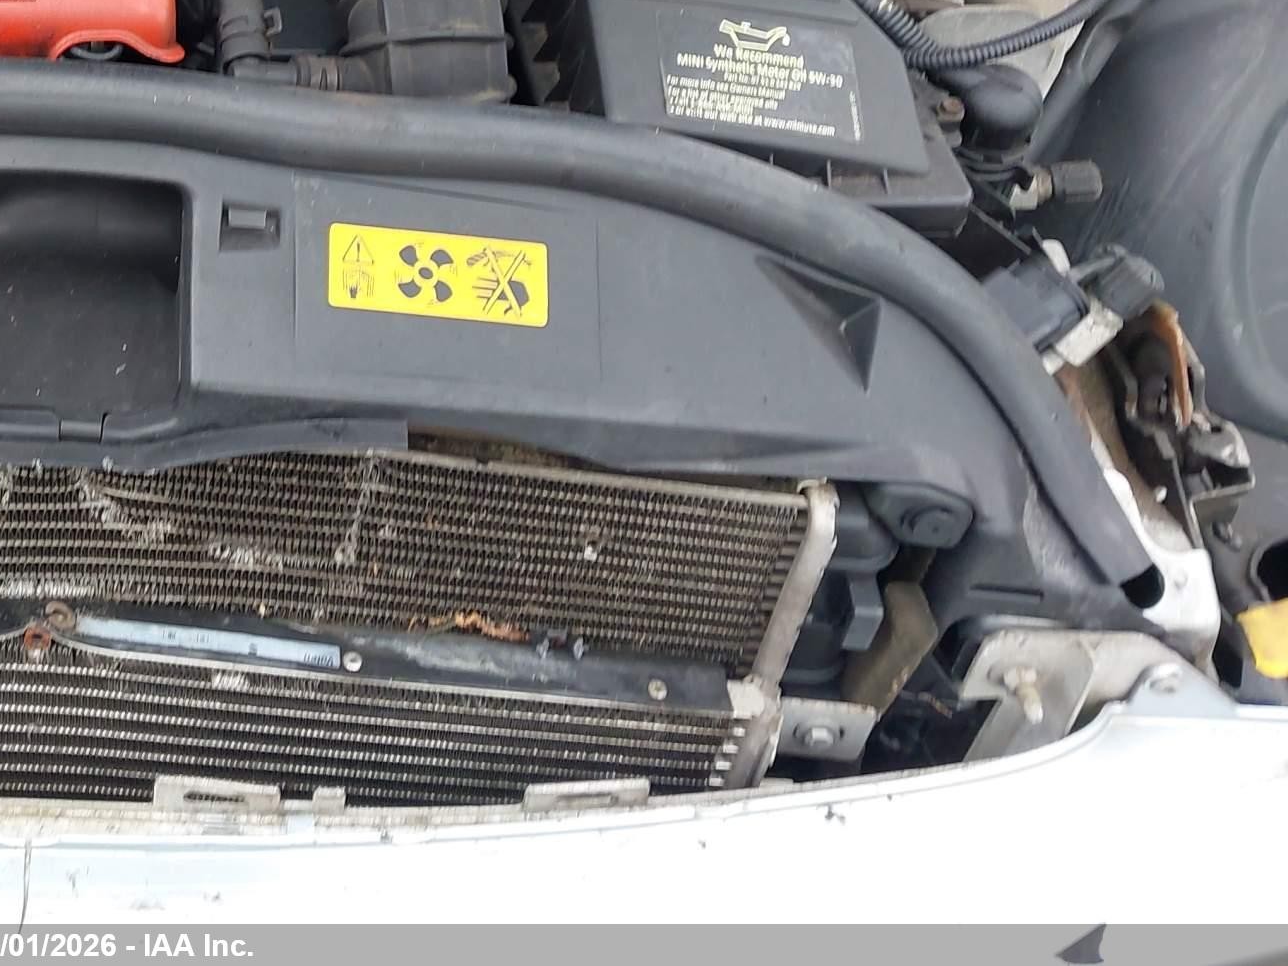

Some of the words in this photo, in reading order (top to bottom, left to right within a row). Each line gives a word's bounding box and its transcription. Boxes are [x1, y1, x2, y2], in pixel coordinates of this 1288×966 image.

[677, 53, 704, 69] MINI
[705, 58, 756, 77] Synthetic
[756, 65, 790, 82] Motor
[735, 47, 805, 69] Recommend
